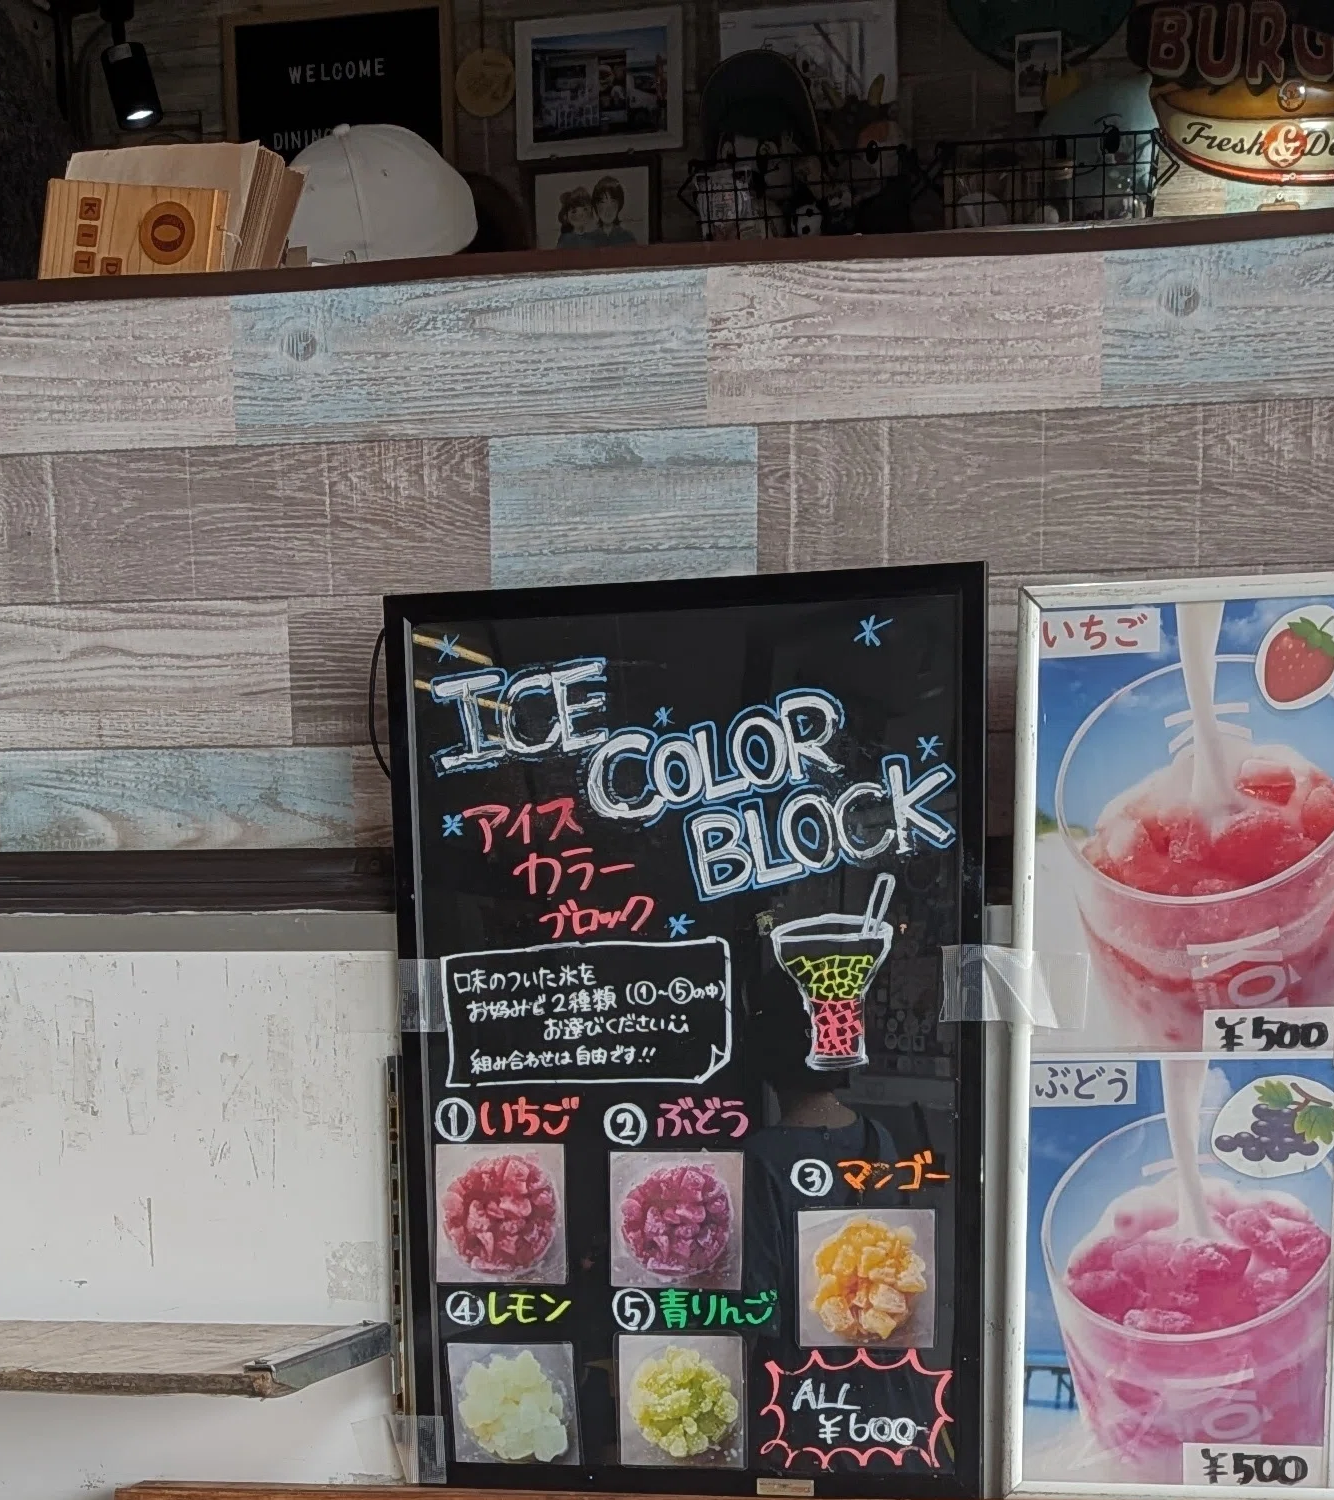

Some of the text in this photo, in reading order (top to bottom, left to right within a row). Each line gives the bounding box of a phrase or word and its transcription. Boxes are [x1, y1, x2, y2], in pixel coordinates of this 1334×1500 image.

[288, 57, 386, 84] WELCOME
[1182, 121, 1264, 156] Fresh
[1041, 612, 1149, 652] いちご
[430, 657, 608, 776] ICE
[586, 688, 845, 826] COLOR
[463, 797, 583, 853] アイス
[685, 755, 957, 901] BLOCK
[513, 847, 635, 895] カラー
[539, 896, 655, 938] ブロック
[454, 963, 597, 994] 味のついた氷を
[1215, 1015, 1329, 1053] ¥500
[1035, 1069, 1130, 1101] ぶどう
[479, 1096, 580, 1136] いちご
[657, 1097, 749, 1138] ぶどう
[836, 1150, 951, 1191] マンゴー
[488, 1291, 572, 1325] レモン
[658, 1288, 779, 1329] 青りんご
[791, 1378, 862, 1412] ALL
[1201, 1447, 1309, 1487] ¥500
